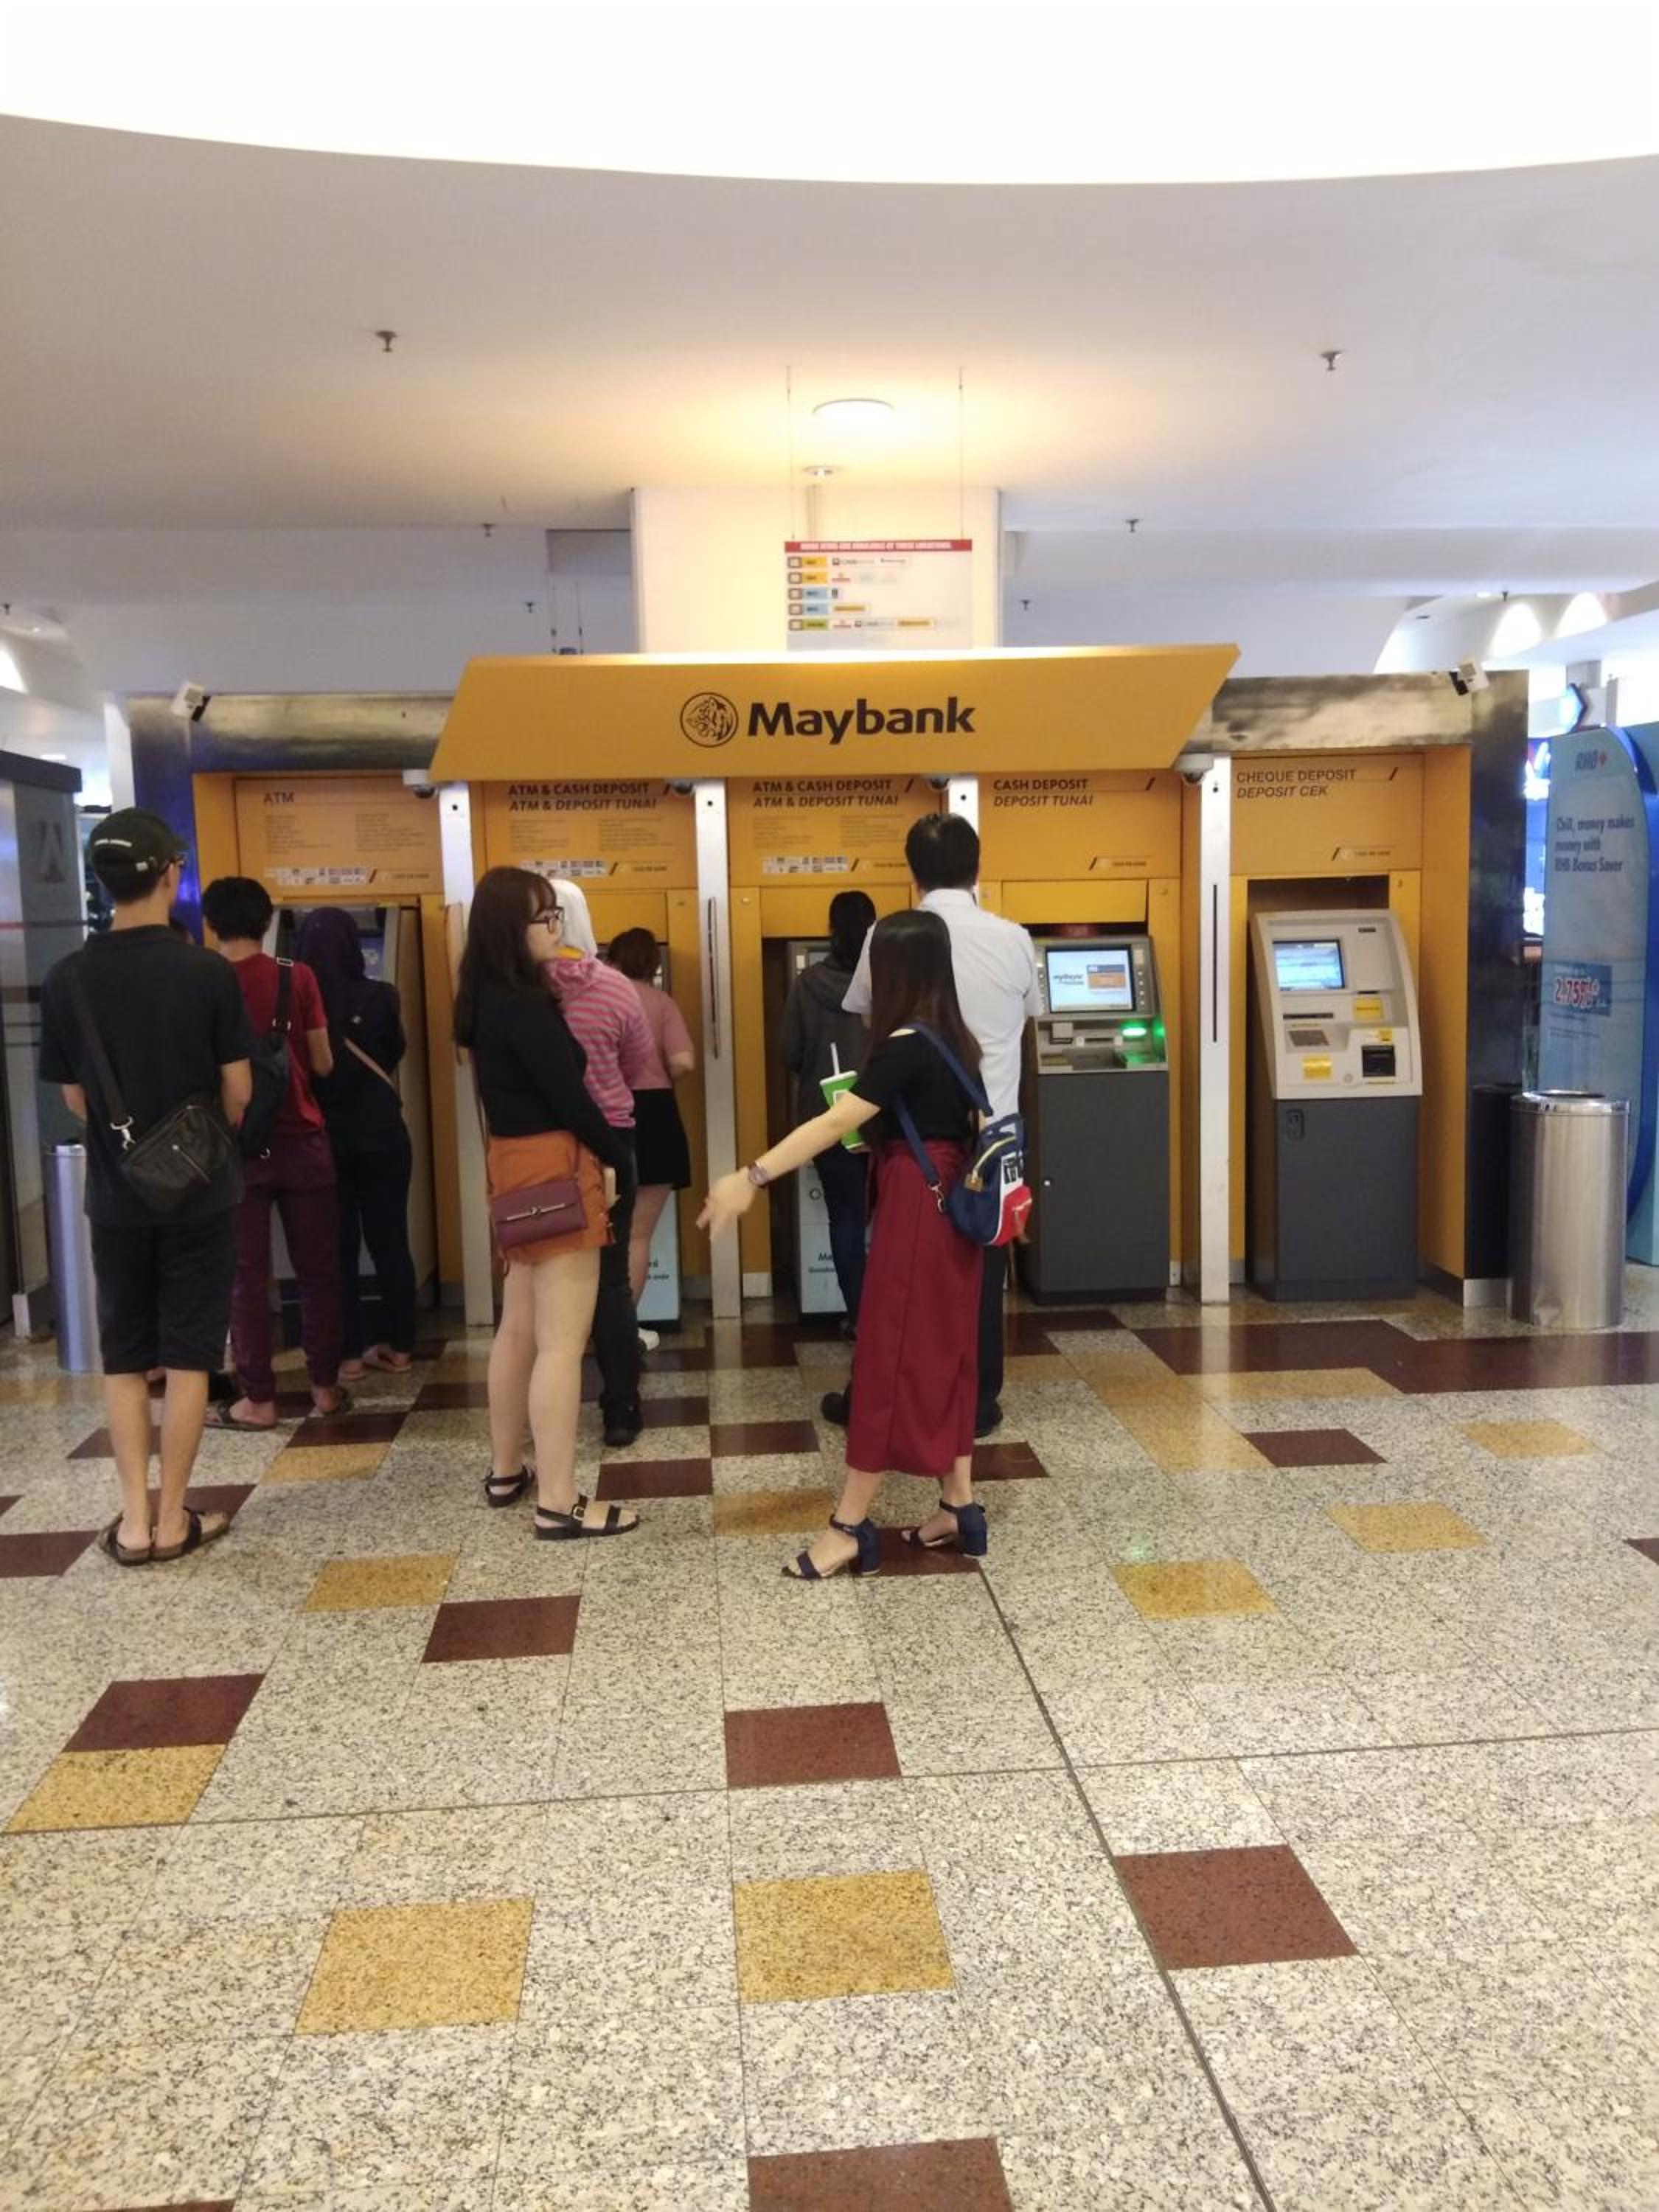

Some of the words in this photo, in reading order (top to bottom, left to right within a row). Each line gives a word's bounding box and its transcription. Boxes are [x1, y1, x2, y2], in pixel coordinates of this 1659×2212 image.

[747, 696, 975, 745] Maybank
[1576, 750, 1598, 771] RHB
[1236, 771, 1295, 783] CHEQUE
[1298, 769, 1356, 781] DEPOSIT
[508, 785, 538, 796] ATM
[540, 784, 550, 796] &
[554, 783, 589, 795] CASH
[591, 782, 649, 794] DEPOSIT
[753, 782, 782, 793] ATM
[785, 781, 794, 792] &
[798, 780, 833, 791] CASH
[835, 779, 892, 790] DEPOSIT
[993, 780, 1029, 791] CASH
[1032, 779, 1088, 790] DEPOSIT
[1237, 786, 1295, 799] DEPOSIT
[1299, 785, 1329, 797] CEK
[263, 791, 294, 804] ATM
[753, 796, 783, 808] ATM
[785, 796, 795, 807] &
[798, 795, 853, 807] DEPOSIT
[855, 794, 899, 806] TUNAI
[993, 796, 1047, 807] DEPOSIT
[1050, 794, 1093, 806] TUNAI
[509, 800, 540, 812] ATM
[542, 799, 552, 811] &
[555, 799, 613, 810] DEPOSIT
[615, 798, 657, 810] TUNAI
[1577, 818, 1605, 834] money
[1607, 814, 1635, 829] makes
[1572, 857, 1598, 872] Bonus
[1599, 857, 1624, 872] Saver
